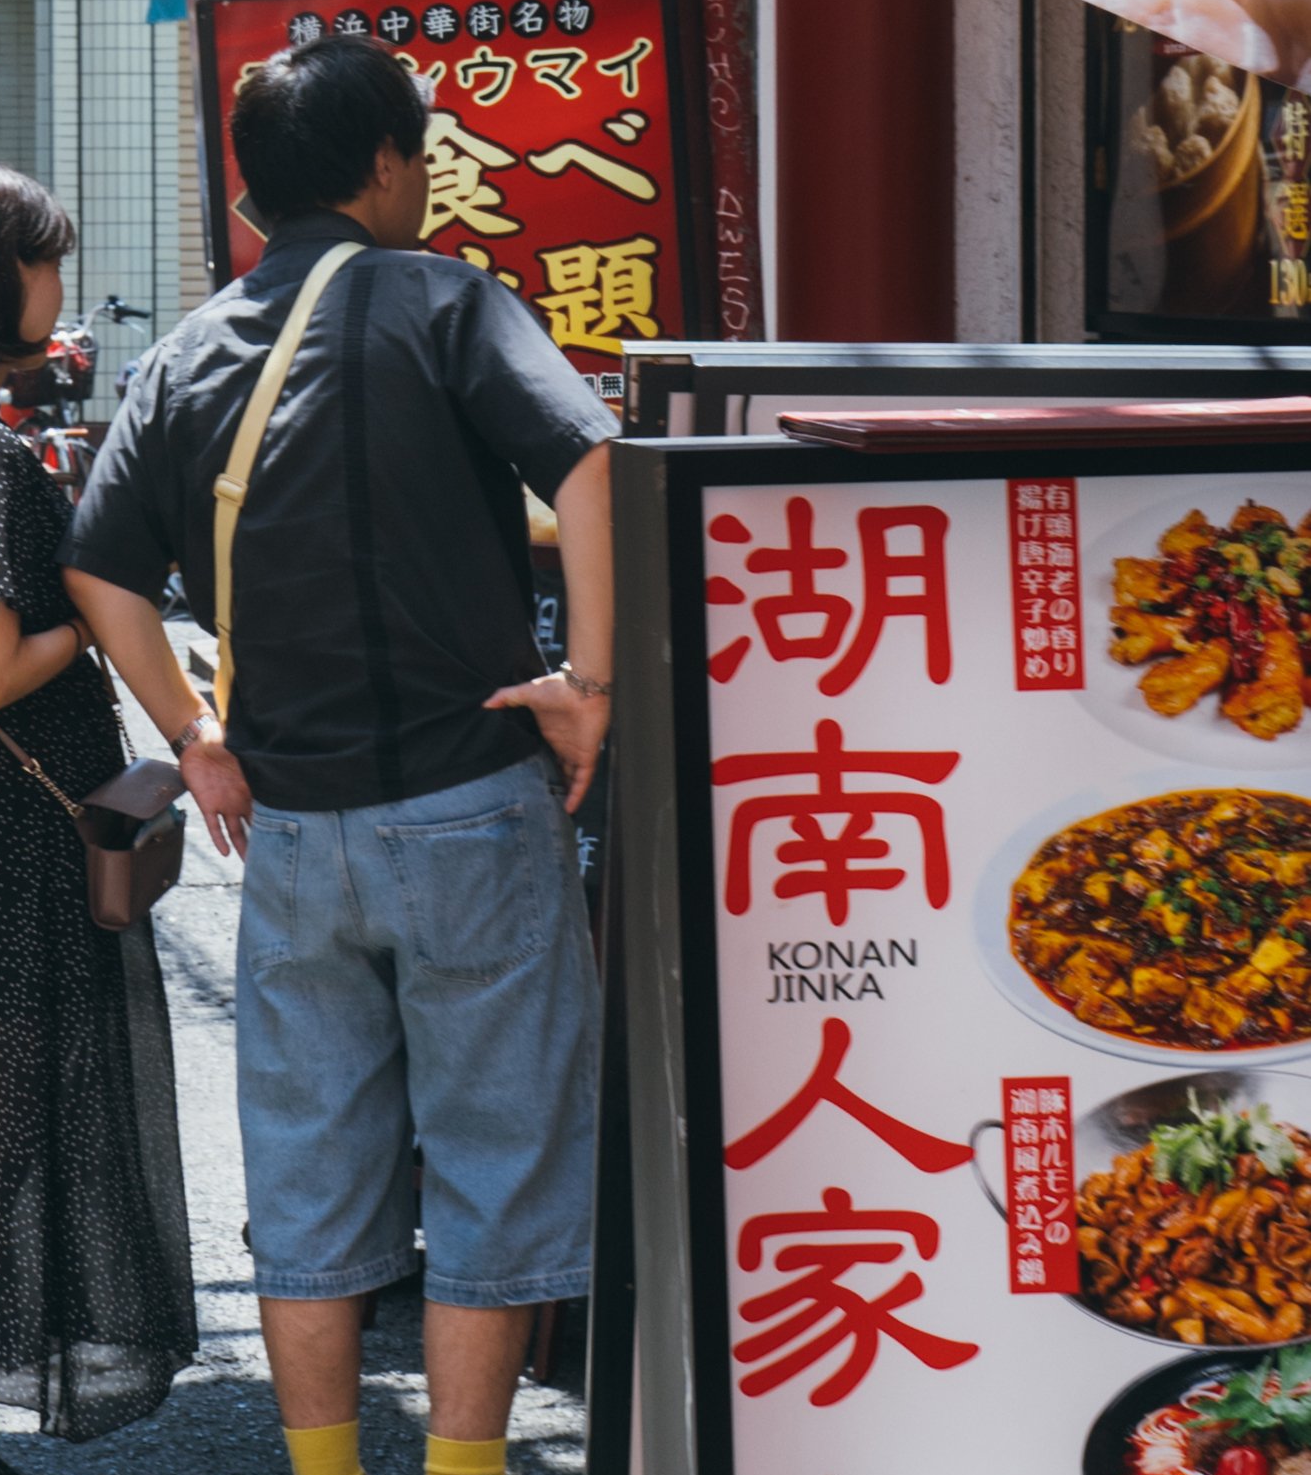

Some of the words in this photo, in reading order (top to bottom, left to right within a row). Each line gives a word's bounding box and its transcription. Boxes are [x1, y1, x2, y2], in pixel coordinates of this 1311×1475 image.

[765, 973, 885, 1005] JINKA
[766, 938, 920, 972] KONAN
[1010, 1087, 1047, 1286] 湖南風煮込み鍋
[1038, 1087, 1072, 1246] 豚ホルモンの
